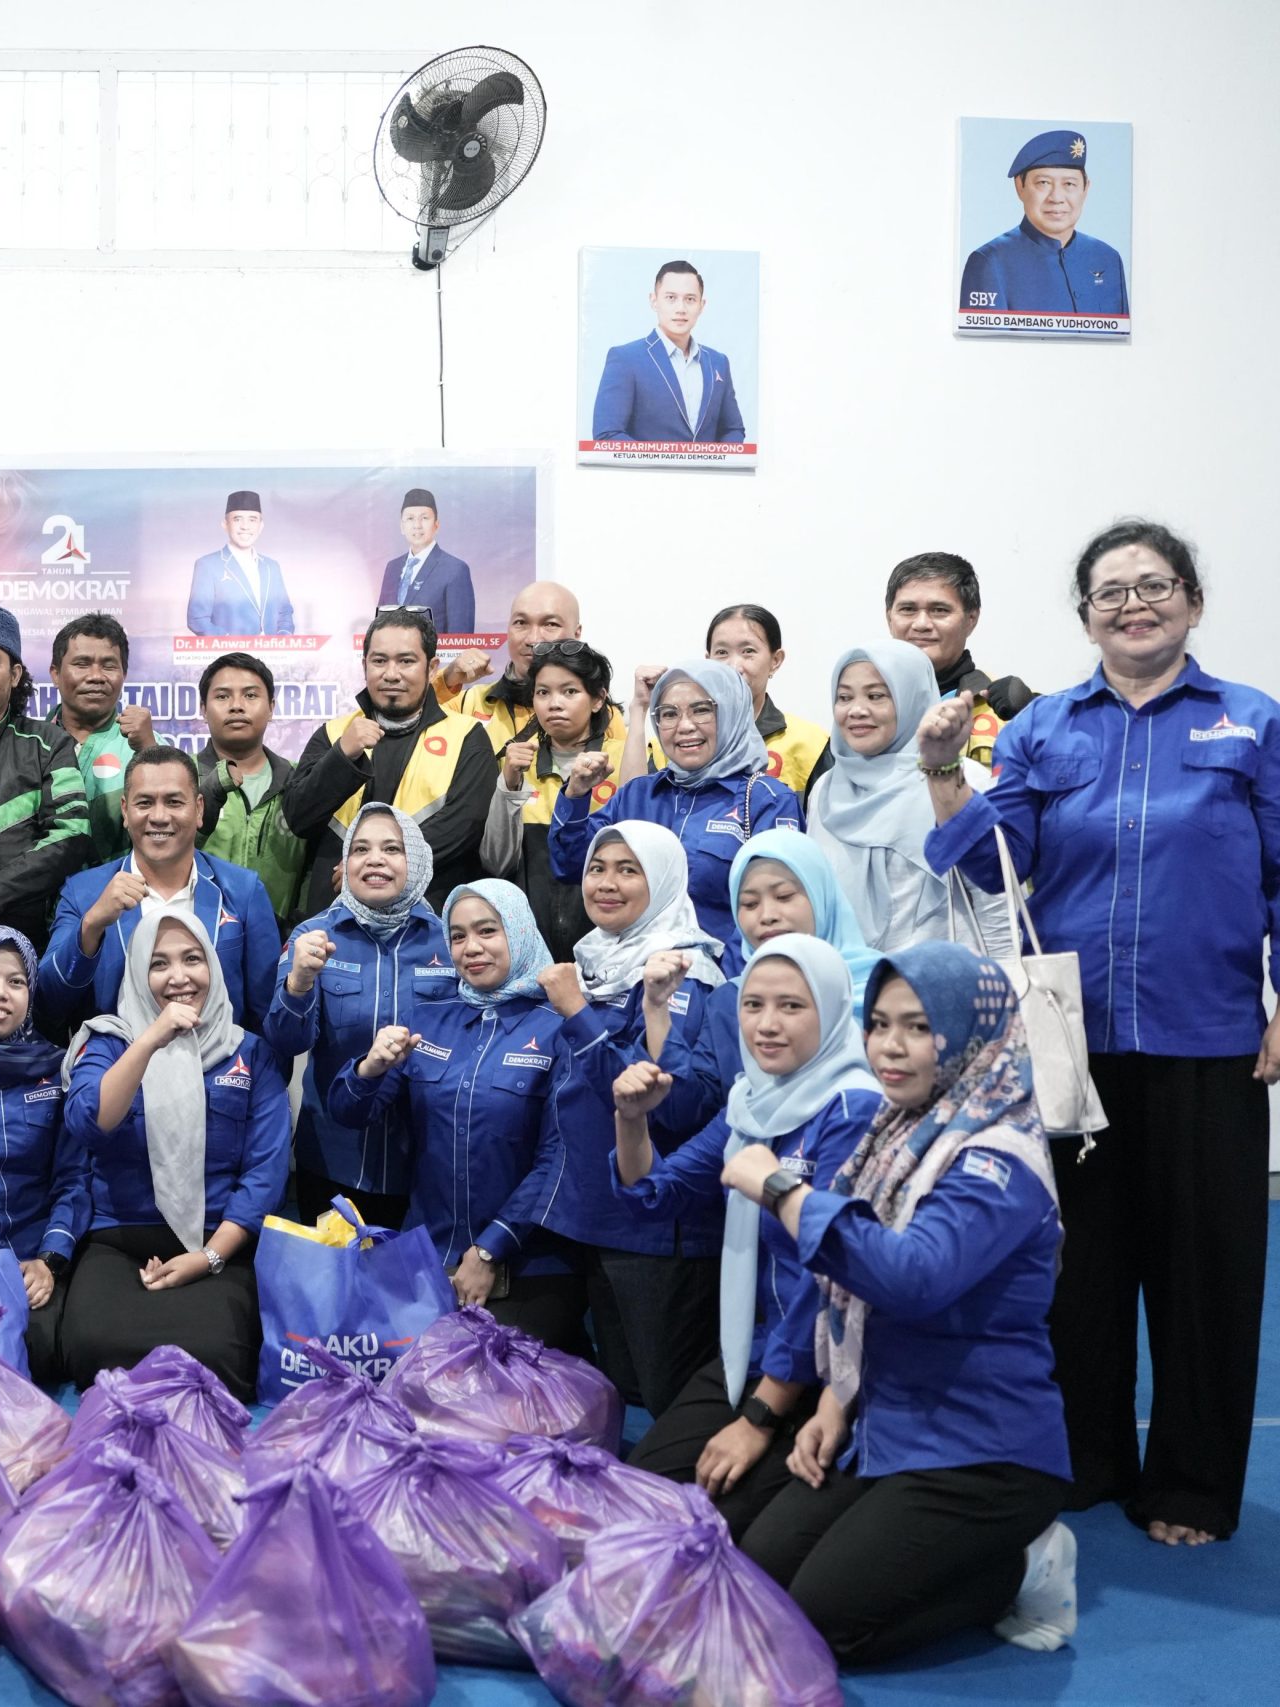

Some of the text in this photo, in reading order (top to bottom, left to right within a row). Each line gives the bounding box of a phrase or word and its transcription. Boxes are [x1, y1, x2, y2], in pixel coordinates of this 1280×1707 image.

[969, 291, 998, 307] SBY
[965, 316, 1118, 330] SUSILO BAMBANG YUDHOYONO
[593, 441, 745, 453] AGUS HARIMURTI YUDHOYONO
[41, 514, 91, 575] 24
[175, 639, 192, 649] Dr.
[195, 639, 209, 649] H.
[211, 639, 251, 649] Anwar
[436, 637, 488, 648] AKAMUNDI,
[489, 637, 501, 646] SE
[416, 967, 455, 977] DEMOKRAT
[508, 1056, 548, 1066] DEMOKRAT
[325, 1331, 379, 1357] AKU
